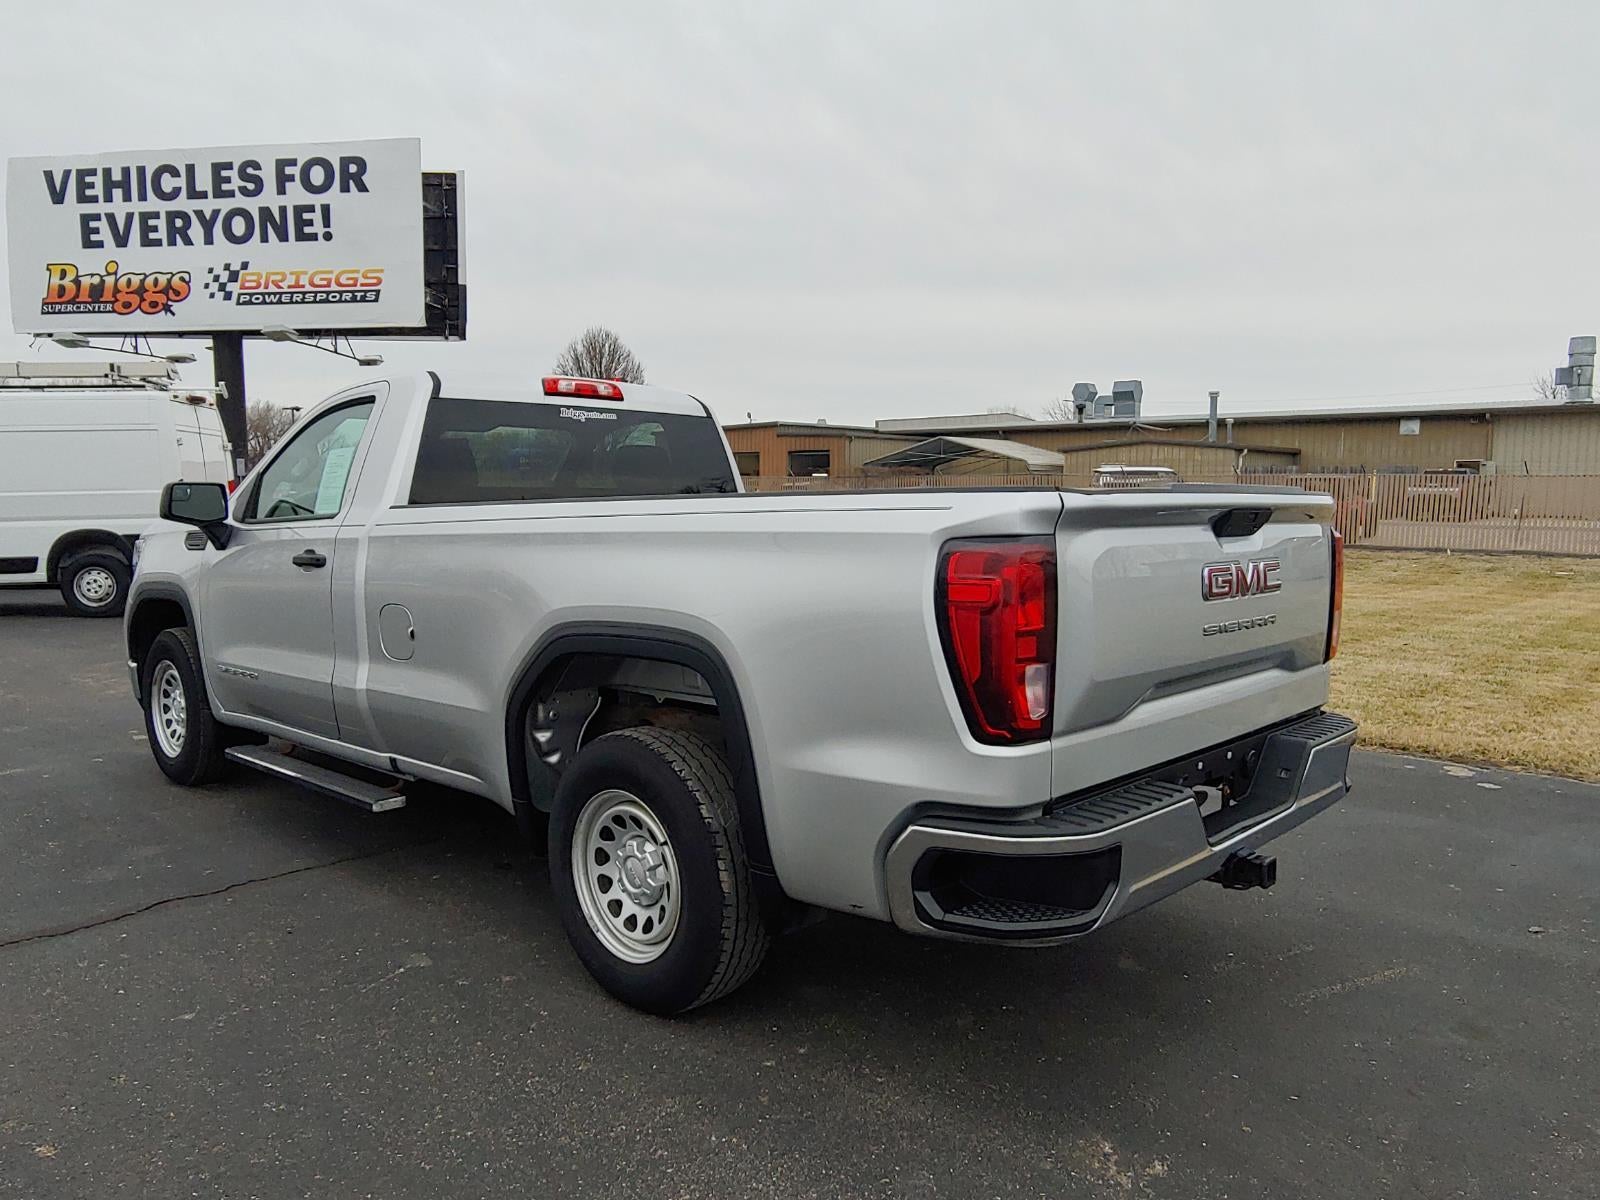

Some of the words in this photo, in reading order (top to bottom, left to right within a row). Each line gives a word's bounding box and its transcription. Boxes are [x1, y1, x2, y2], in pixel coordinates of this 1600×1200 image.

[43, 159, 265, 205] VEHICLES
[275, 156, 370, 195] FOR
[79, 203, 333, 249] EVERYONE!
[43, 260, 191, 315] Briggs
[238, 268, 385, 291] BRIGGS
[42, 302, 113, 313] SUPERCENTER
[239, 291, 378, 304] POWERSPORTS
[1202, 557, 1282, 601] GMC
[1203, 614, 1277, 636] SIERRA
